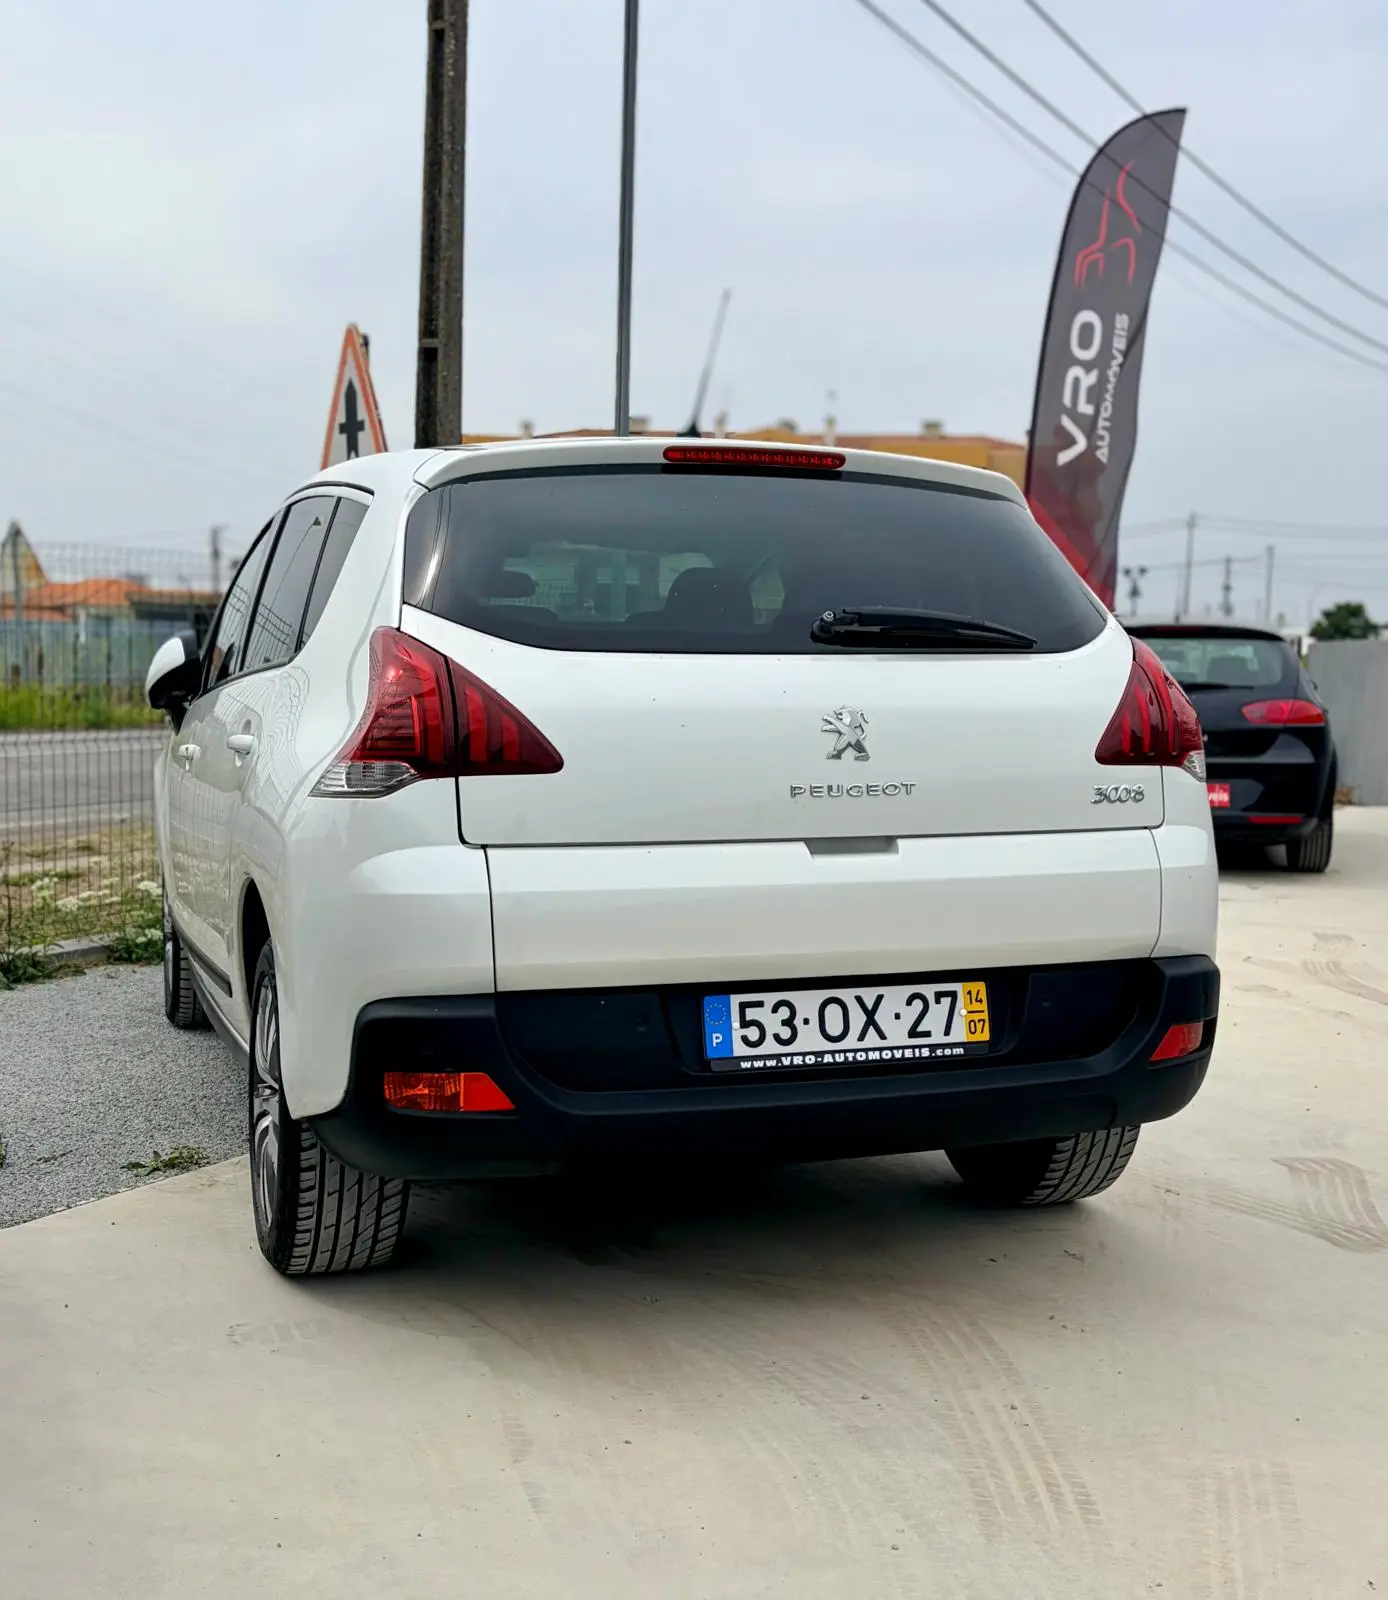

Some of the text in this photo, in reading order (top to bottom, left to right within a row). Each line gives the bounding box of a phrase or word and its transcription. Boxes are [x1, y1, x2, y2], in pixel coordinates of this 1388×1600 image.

[1056, 309, 1103, 467] VRO
[790, 781, 916, 798] PEUGEOT
[1090, 784, 1145, 804] 3008
[966, 989, 983, 1005] 14
[968, 1018, 986, 1035] 07
[712, 1033, 723, 1047] P
[740, 1047, 965, 1069] www.VRO-AUTOMOVEIS.com
